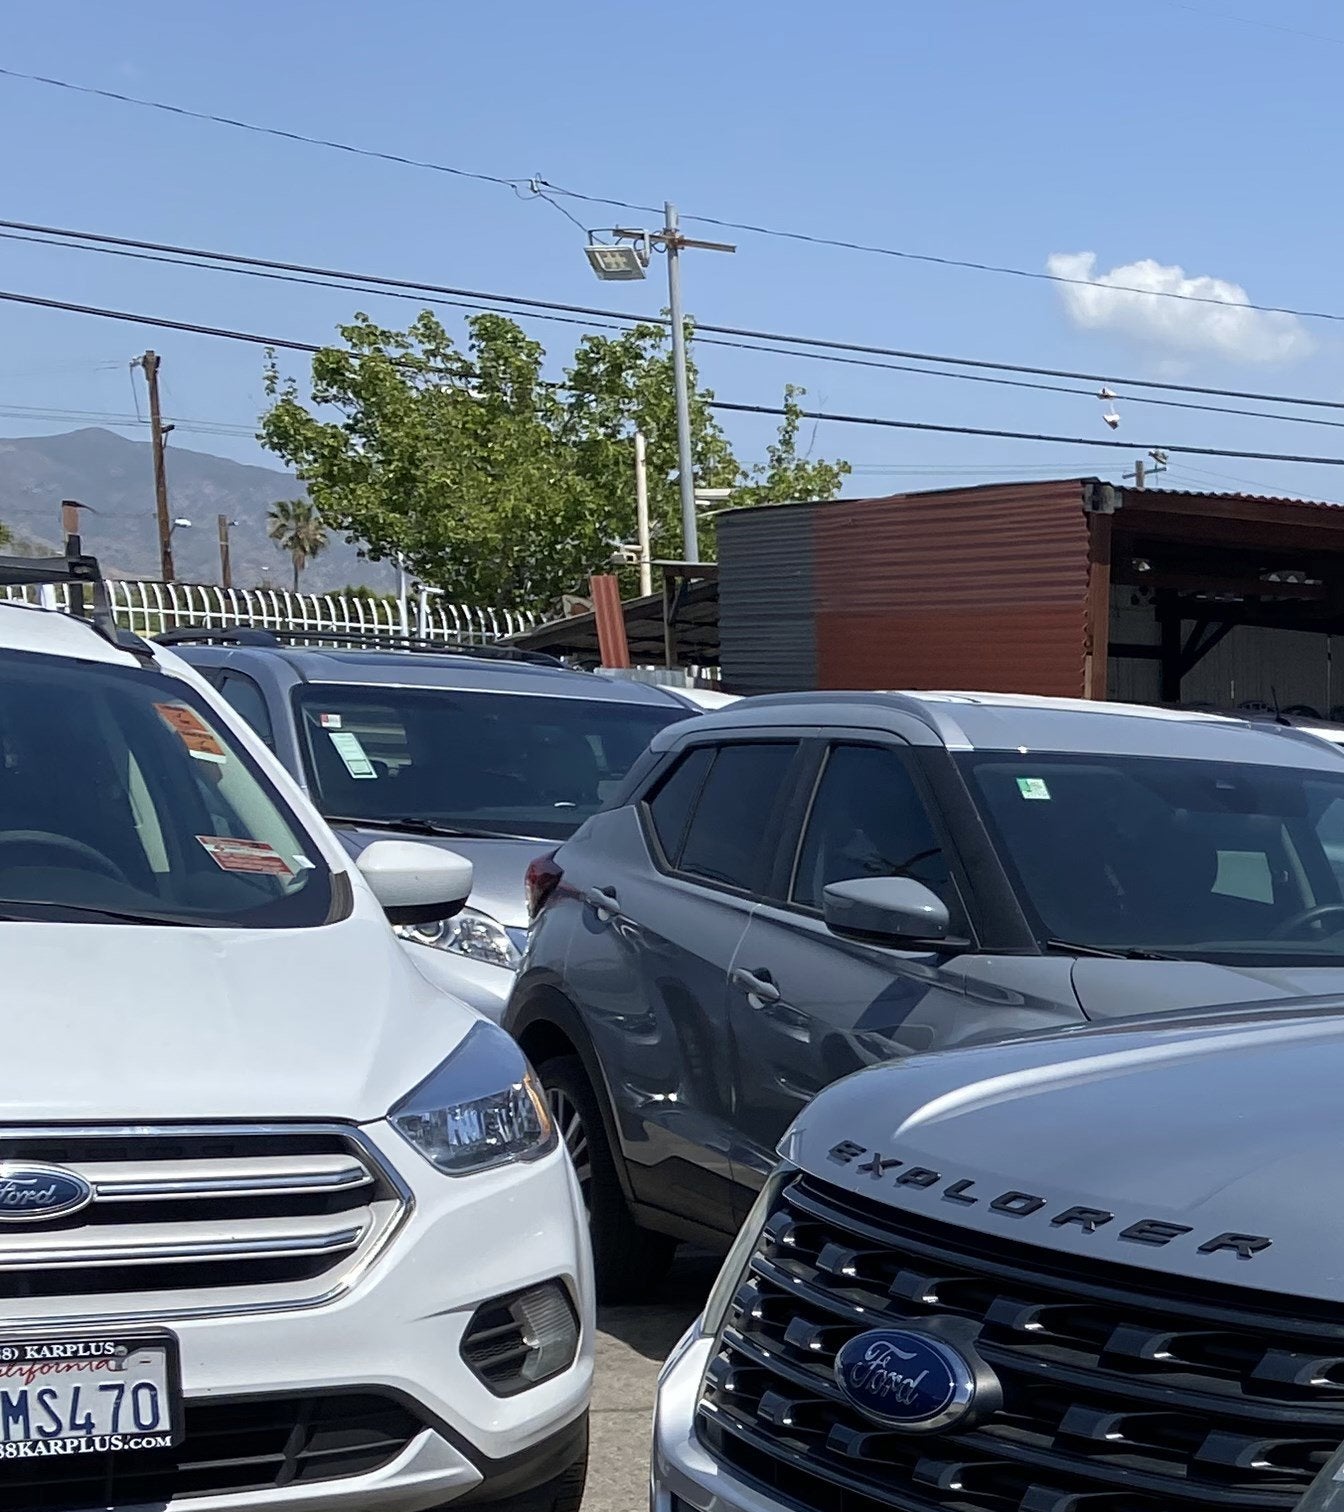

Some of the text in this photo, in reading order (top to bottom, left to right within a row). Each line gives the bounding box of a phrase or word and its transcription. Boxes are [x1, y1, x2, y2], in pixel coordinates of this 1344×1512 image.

[826, 1139, 1274, 1261] EXPLORER
[24, 1341, 116, 1360] KARPLUS
[849, 1340, 931, 1406] Ford
[0, 1382, 161, 1441] MS470
